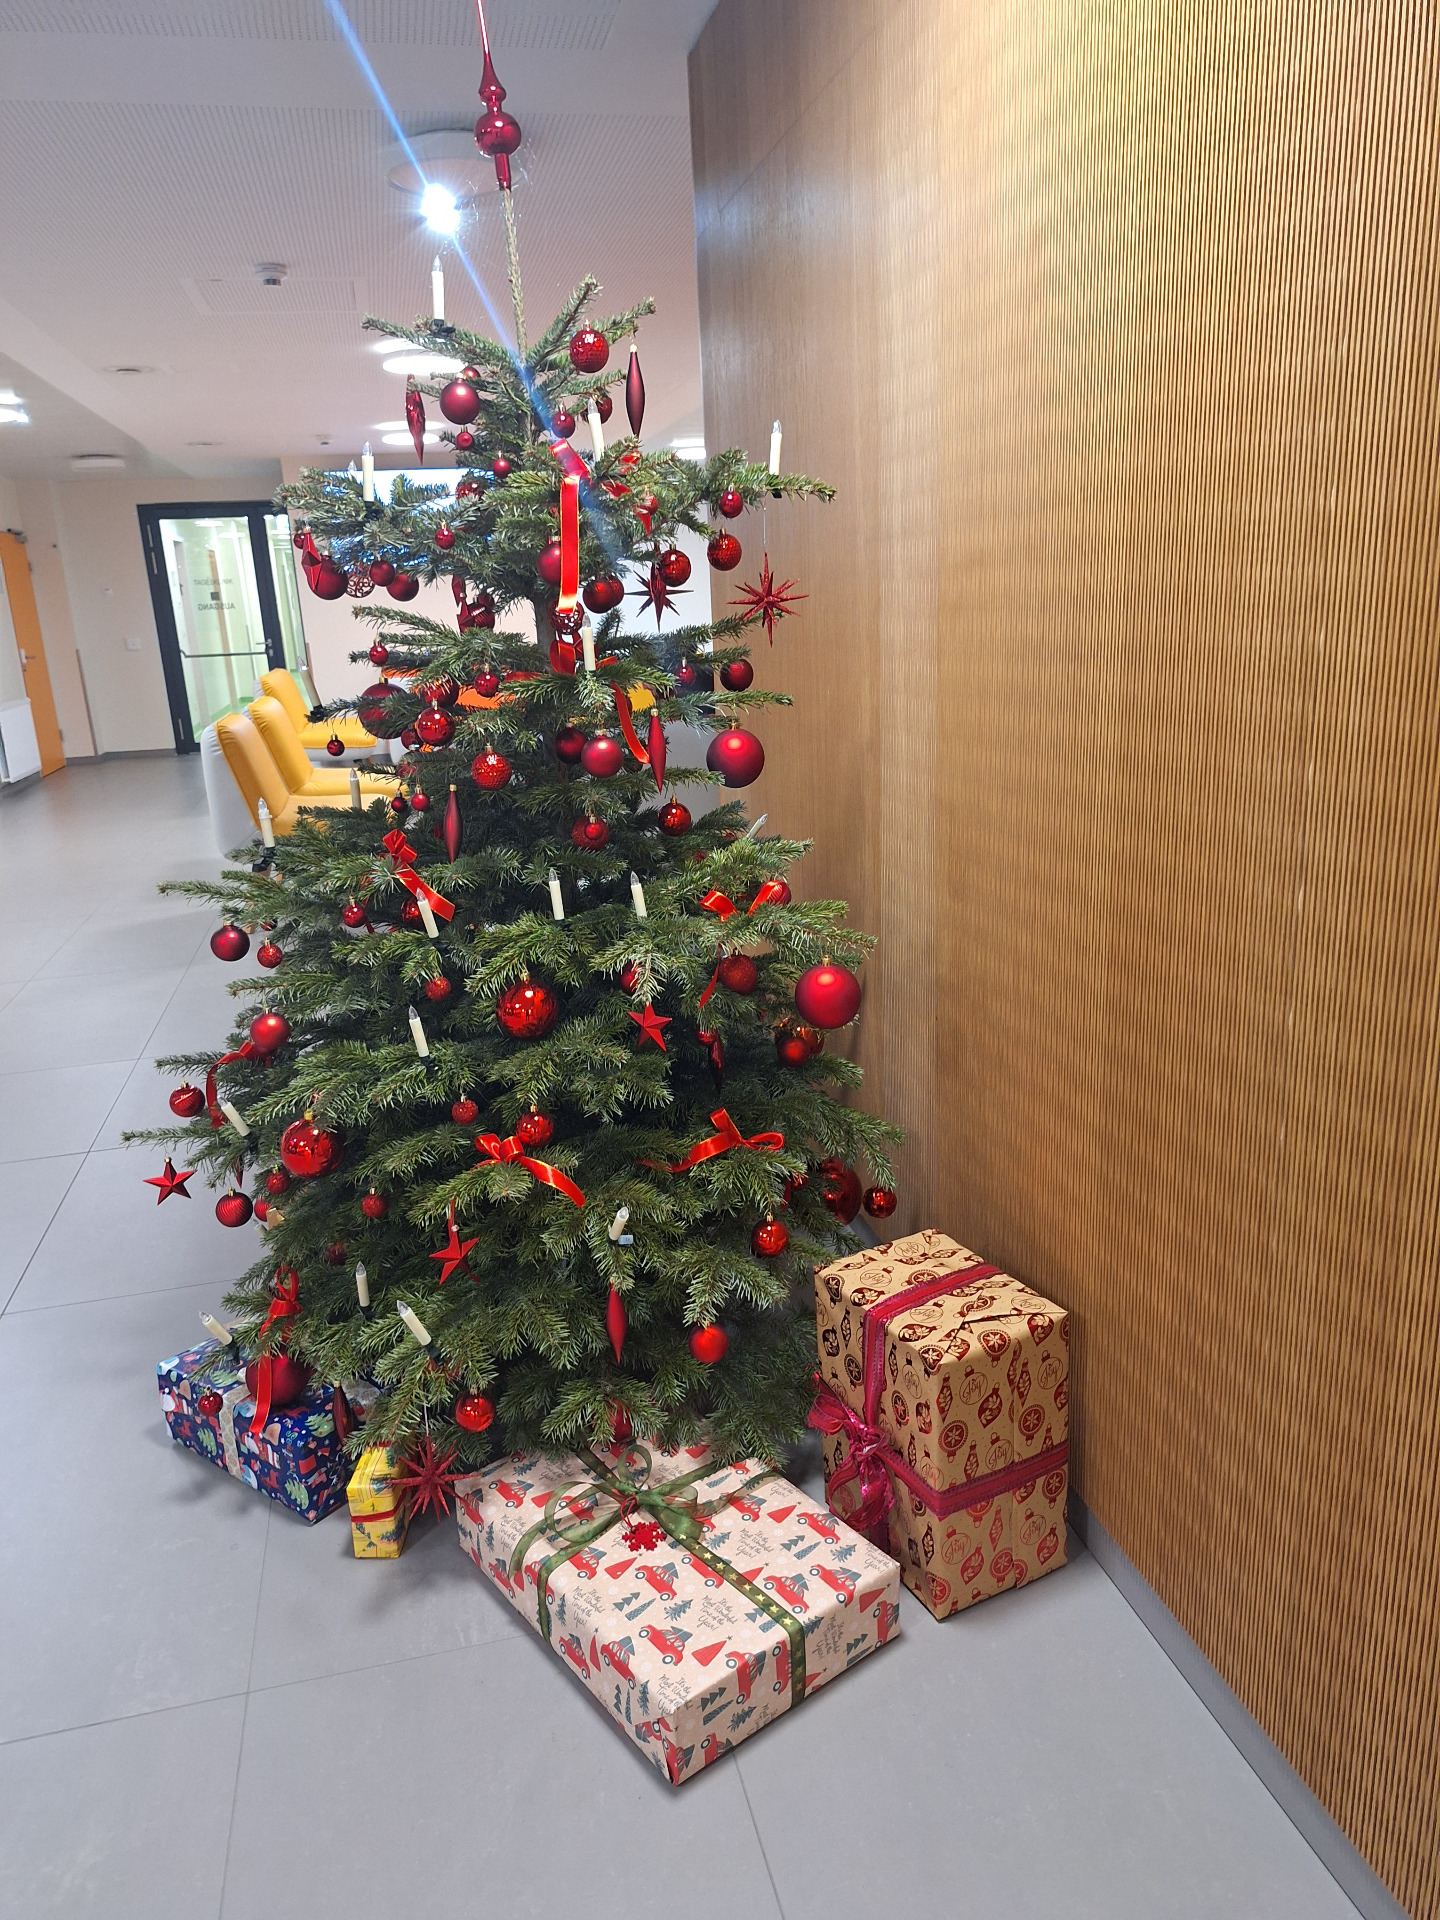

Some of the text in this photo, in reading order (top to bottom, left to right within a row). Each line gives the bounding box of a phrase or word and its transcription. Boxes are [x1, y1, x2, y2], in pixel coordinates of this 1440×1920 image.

[963, 1374, 986, 1403] Joy
[989, 1441, 1011, 1469] Joy
[1023, 1515, 1044, 1543] Joy
[944, 1535, 969, 1562] Joy
